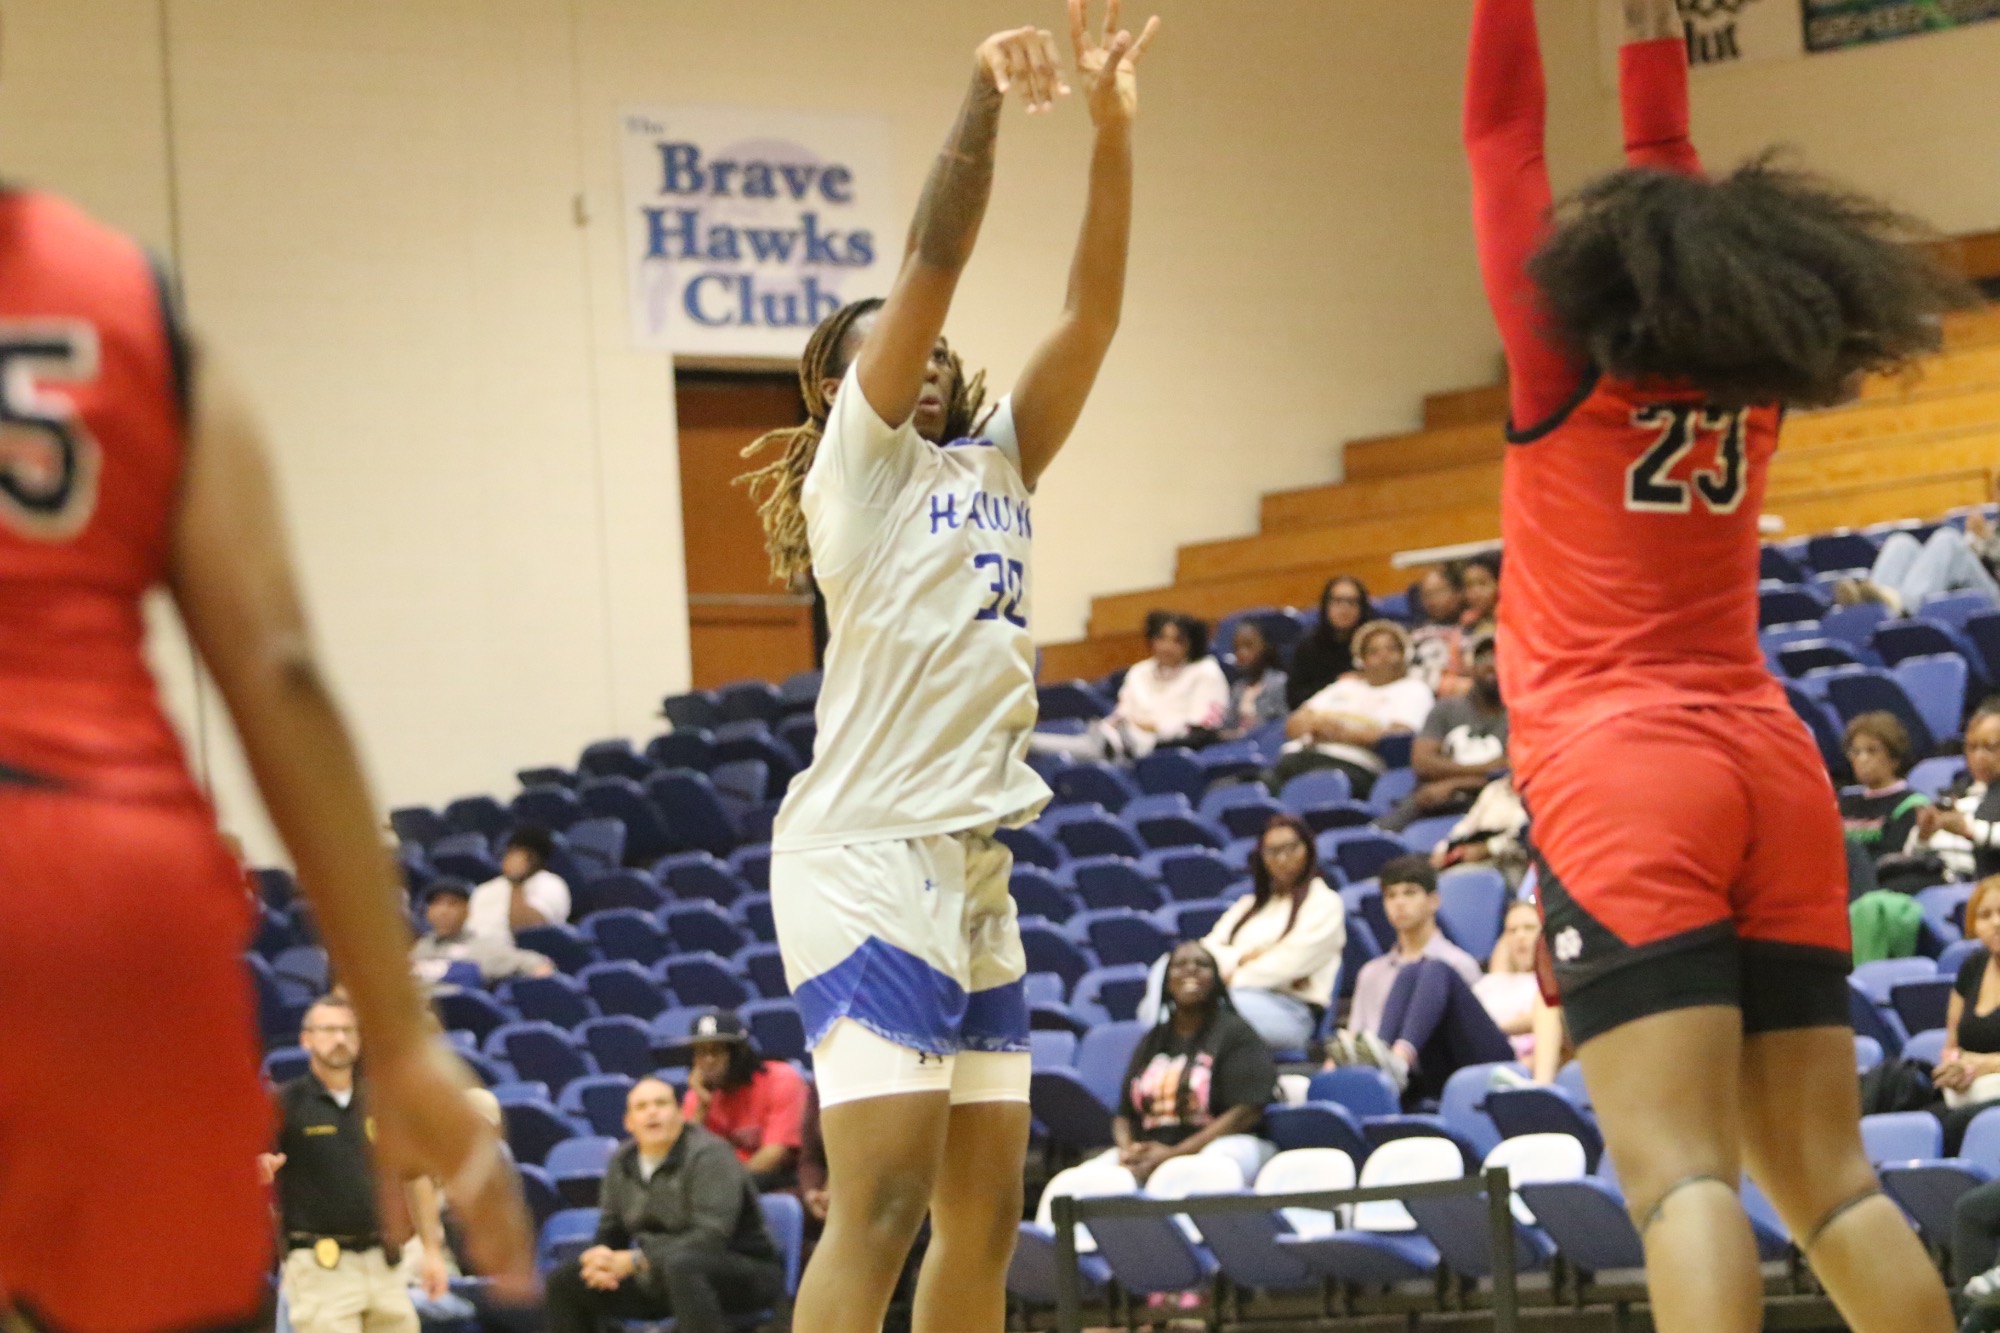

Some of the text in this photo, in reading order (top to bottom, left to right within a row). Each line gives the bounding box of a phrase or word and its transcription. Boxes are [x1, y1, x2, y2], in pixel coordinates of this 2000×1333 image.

[656, 142, 852, 203] Brave
[642, 206, 875, 265] Hawks
[682, 271, 842, 328] Club
[1625, 403, 1748, 514] 23
